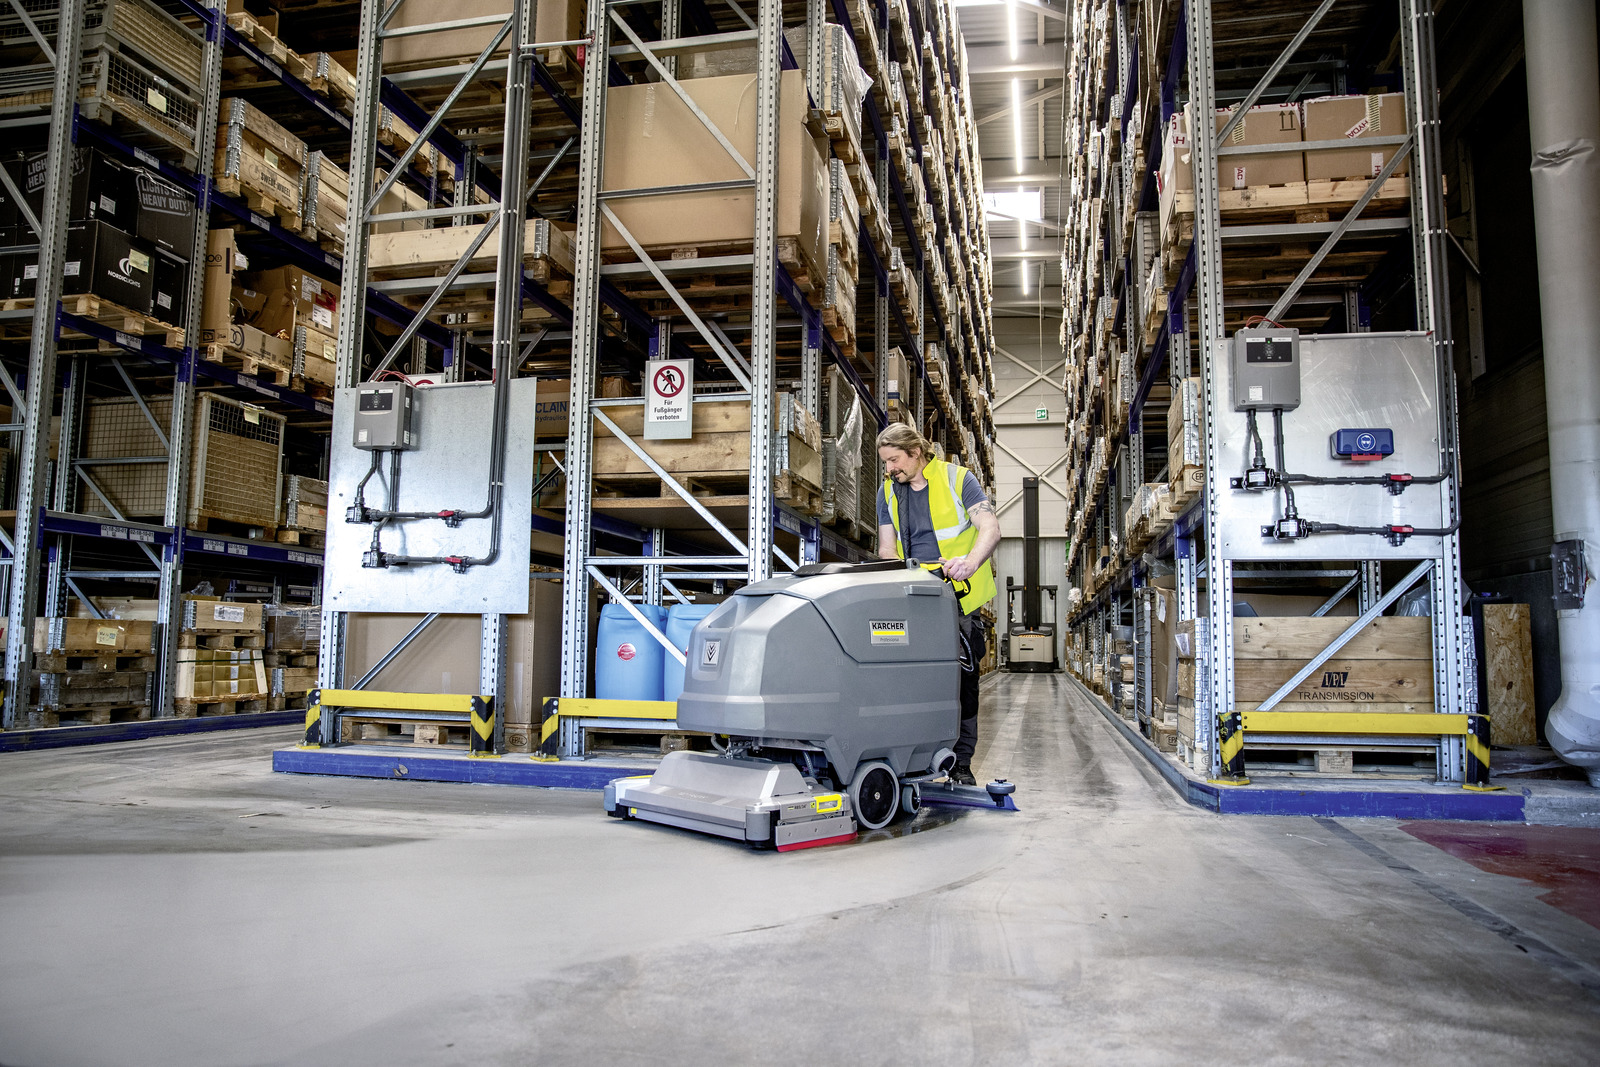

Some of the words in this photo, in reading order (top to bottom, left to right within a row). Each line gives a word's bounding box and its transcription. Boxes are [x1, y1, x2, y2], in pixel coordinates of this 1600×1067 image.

[1347, 120, 1368, 138] HYDA
[27, 158, 48, 176] LIGH
[27, 171, 46, 188] HEA
[141, 179, 169, 196] LIGHTS
[141, 193, 167, 208] HEAVY
[535, 401, 567, 413] CLAIN
[872, 622, 905, 630] KÄRCHER
[1297, 691, 1375, 701] TRANSMISSION
